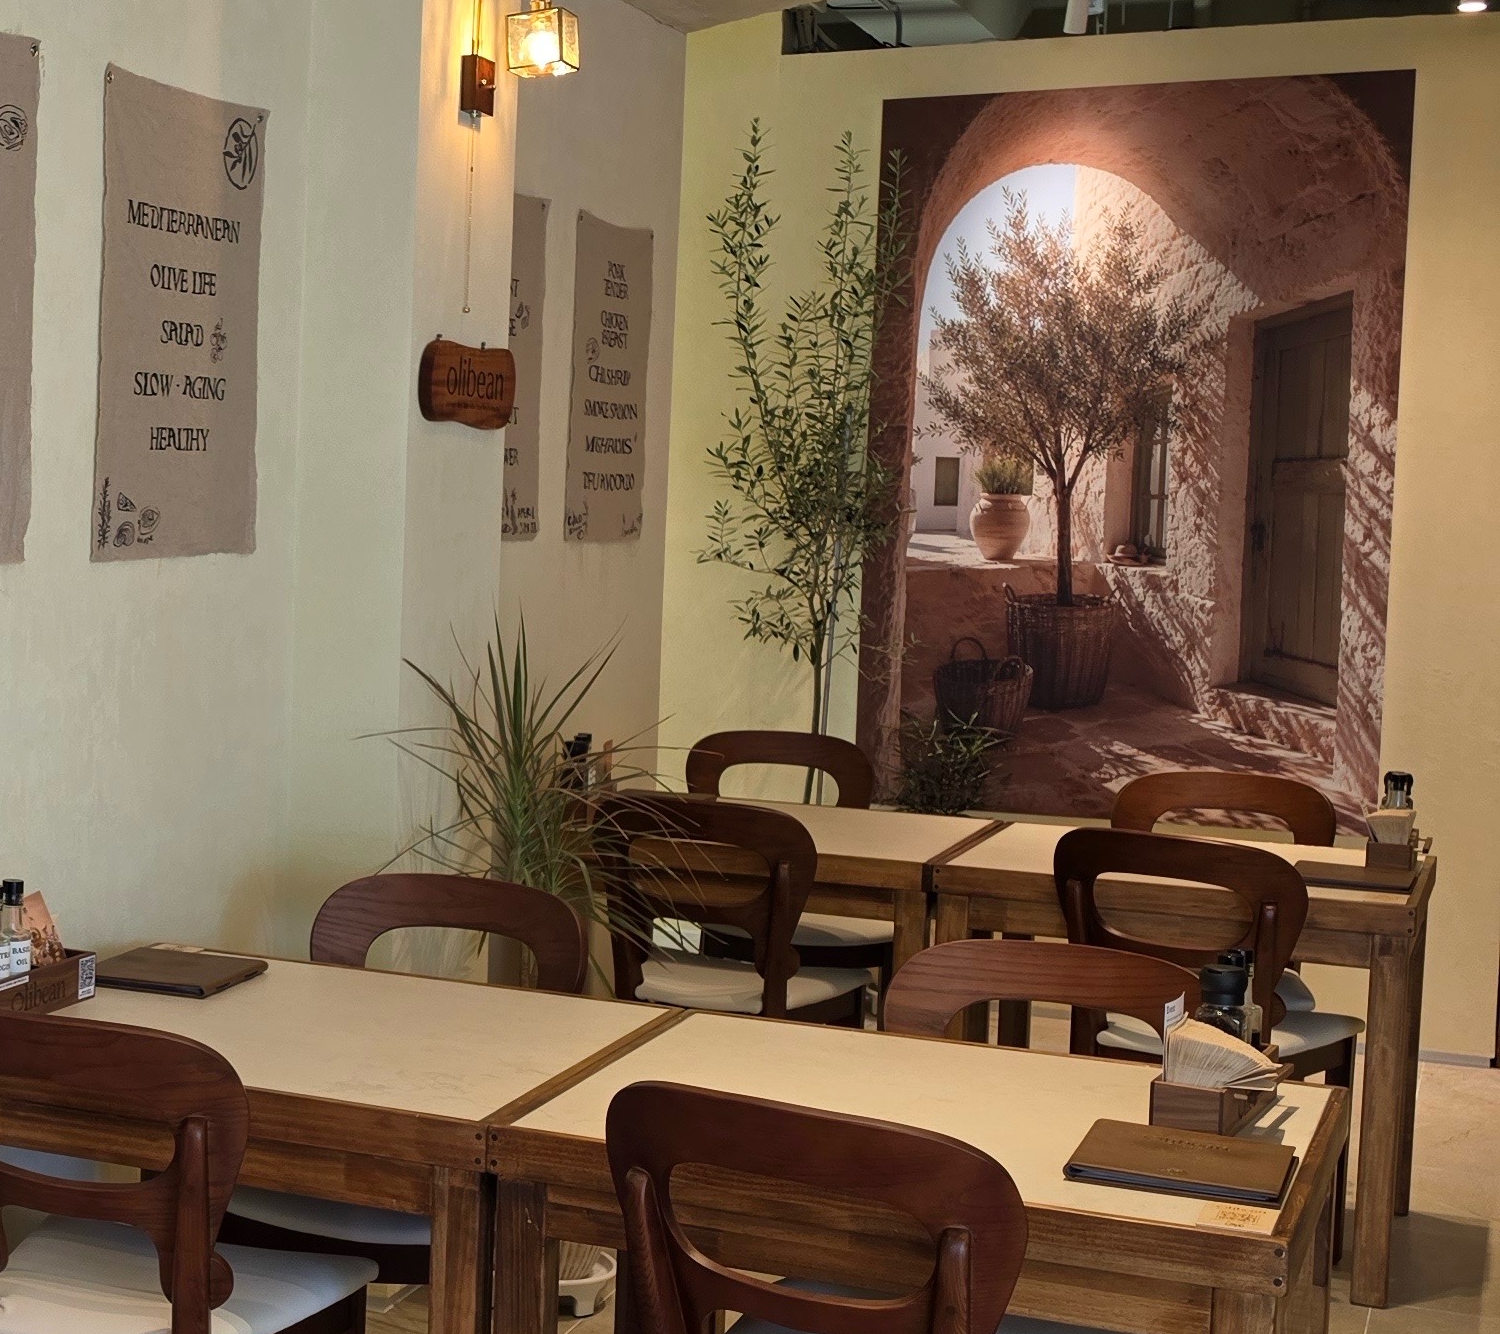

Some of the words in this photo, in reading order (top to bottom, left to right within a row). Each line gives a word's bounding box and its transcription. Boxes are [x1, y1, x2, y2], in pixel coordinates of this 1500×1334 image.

[127, 199, 240, 244] MEDITERRANEAN
[150, 263, 189, 293] OLIVE
[191, 270, 217, 296] LIFE
[160, 319, 204, 347] SALAD
[133, 371, 174, 397] SLOW
[182, 375, 227, 401] AGING
[446, 355, 504, 401] olibean
[149, 426, 210, 451] HEALTHY
